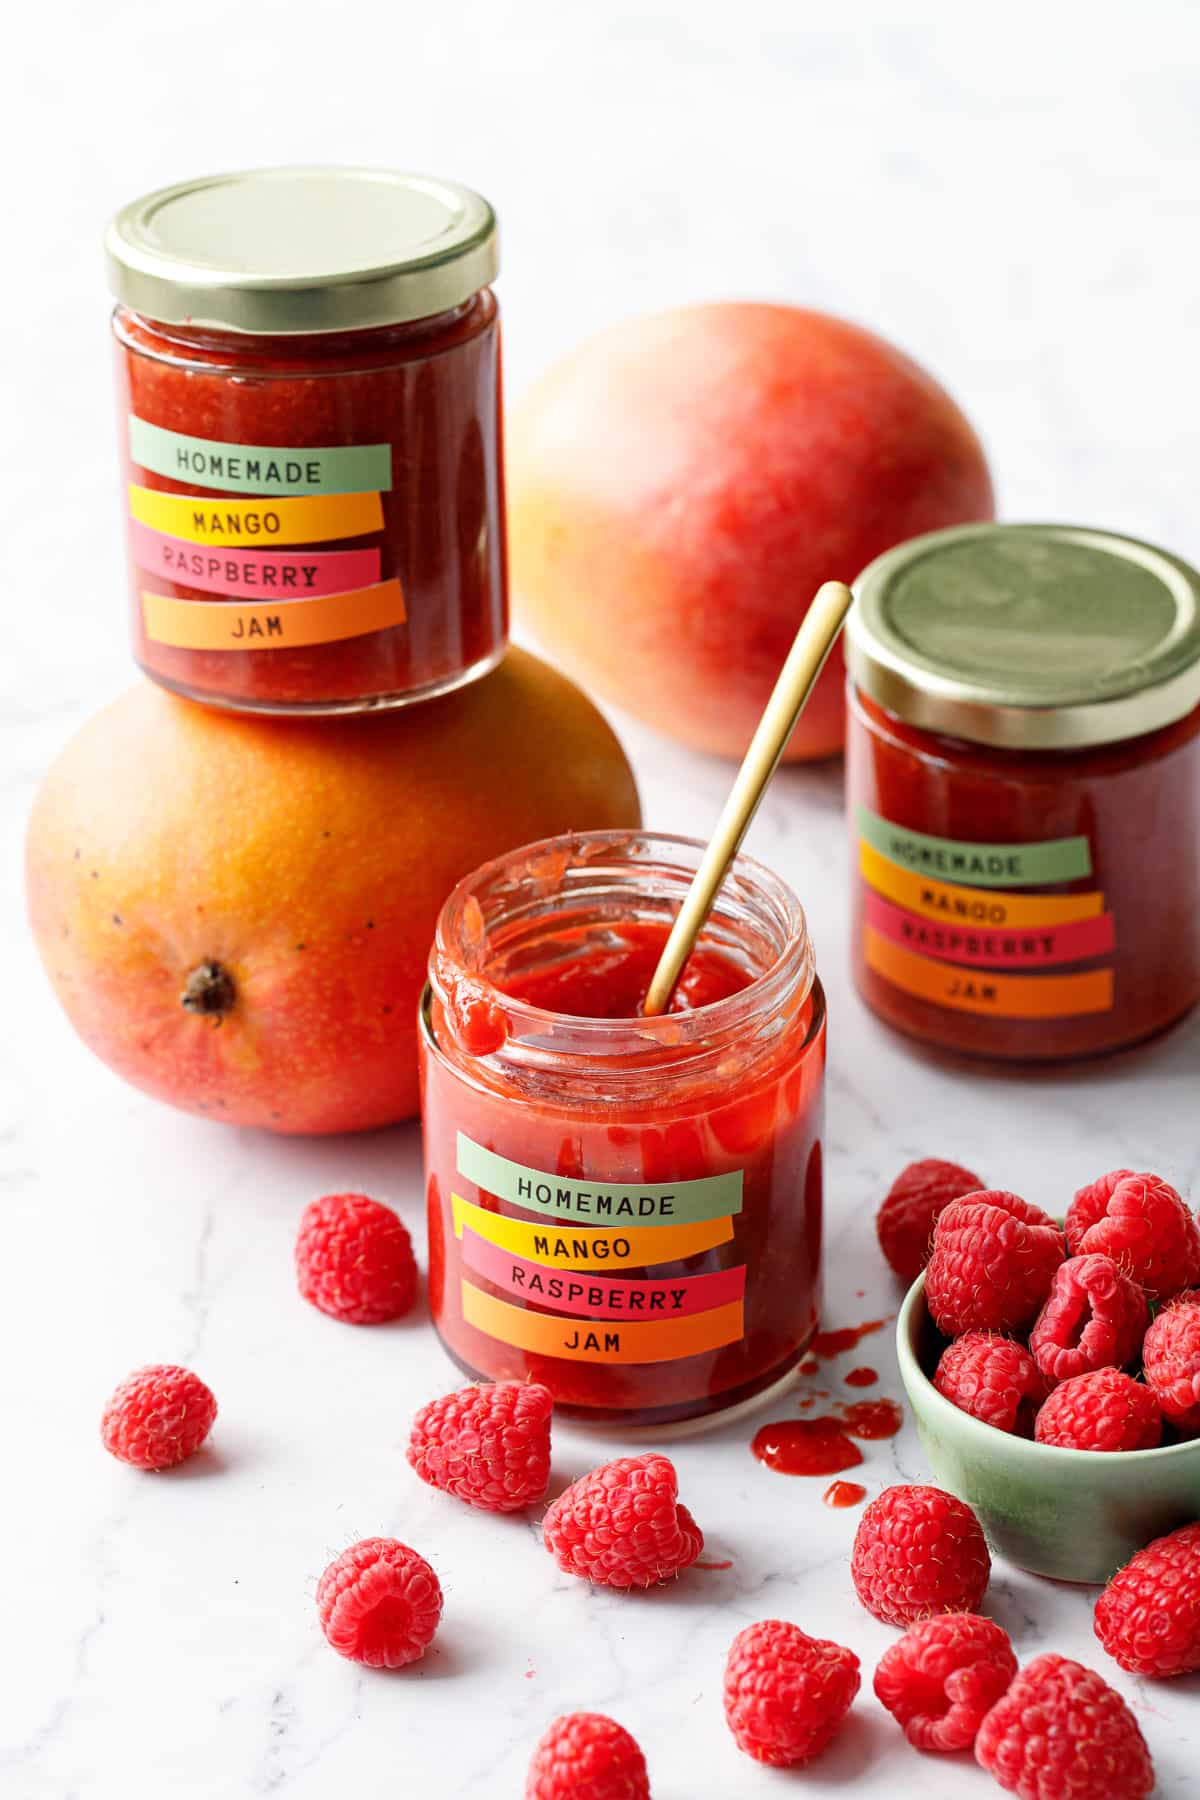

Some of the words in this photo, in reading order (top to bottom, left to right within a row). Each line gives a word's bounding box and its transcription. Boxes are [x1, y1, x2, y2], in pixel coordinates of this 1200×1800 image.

[176, 448, 321, 484] HOMEMADE
[193, 511, 281, 534] MANGO
[162, 545, 319, 587] RASPBERRY
[231, 616, 284, 638] JAM
[949, 981, 996, 1002] JAM
[518, 1177, 675, 1216] HOMEMADE
[534, 1235, 630, 1259] MANGO
[512, 1265, 687, 1310] RASPBERRY
[564, 1331, 620, 1352] JAM
